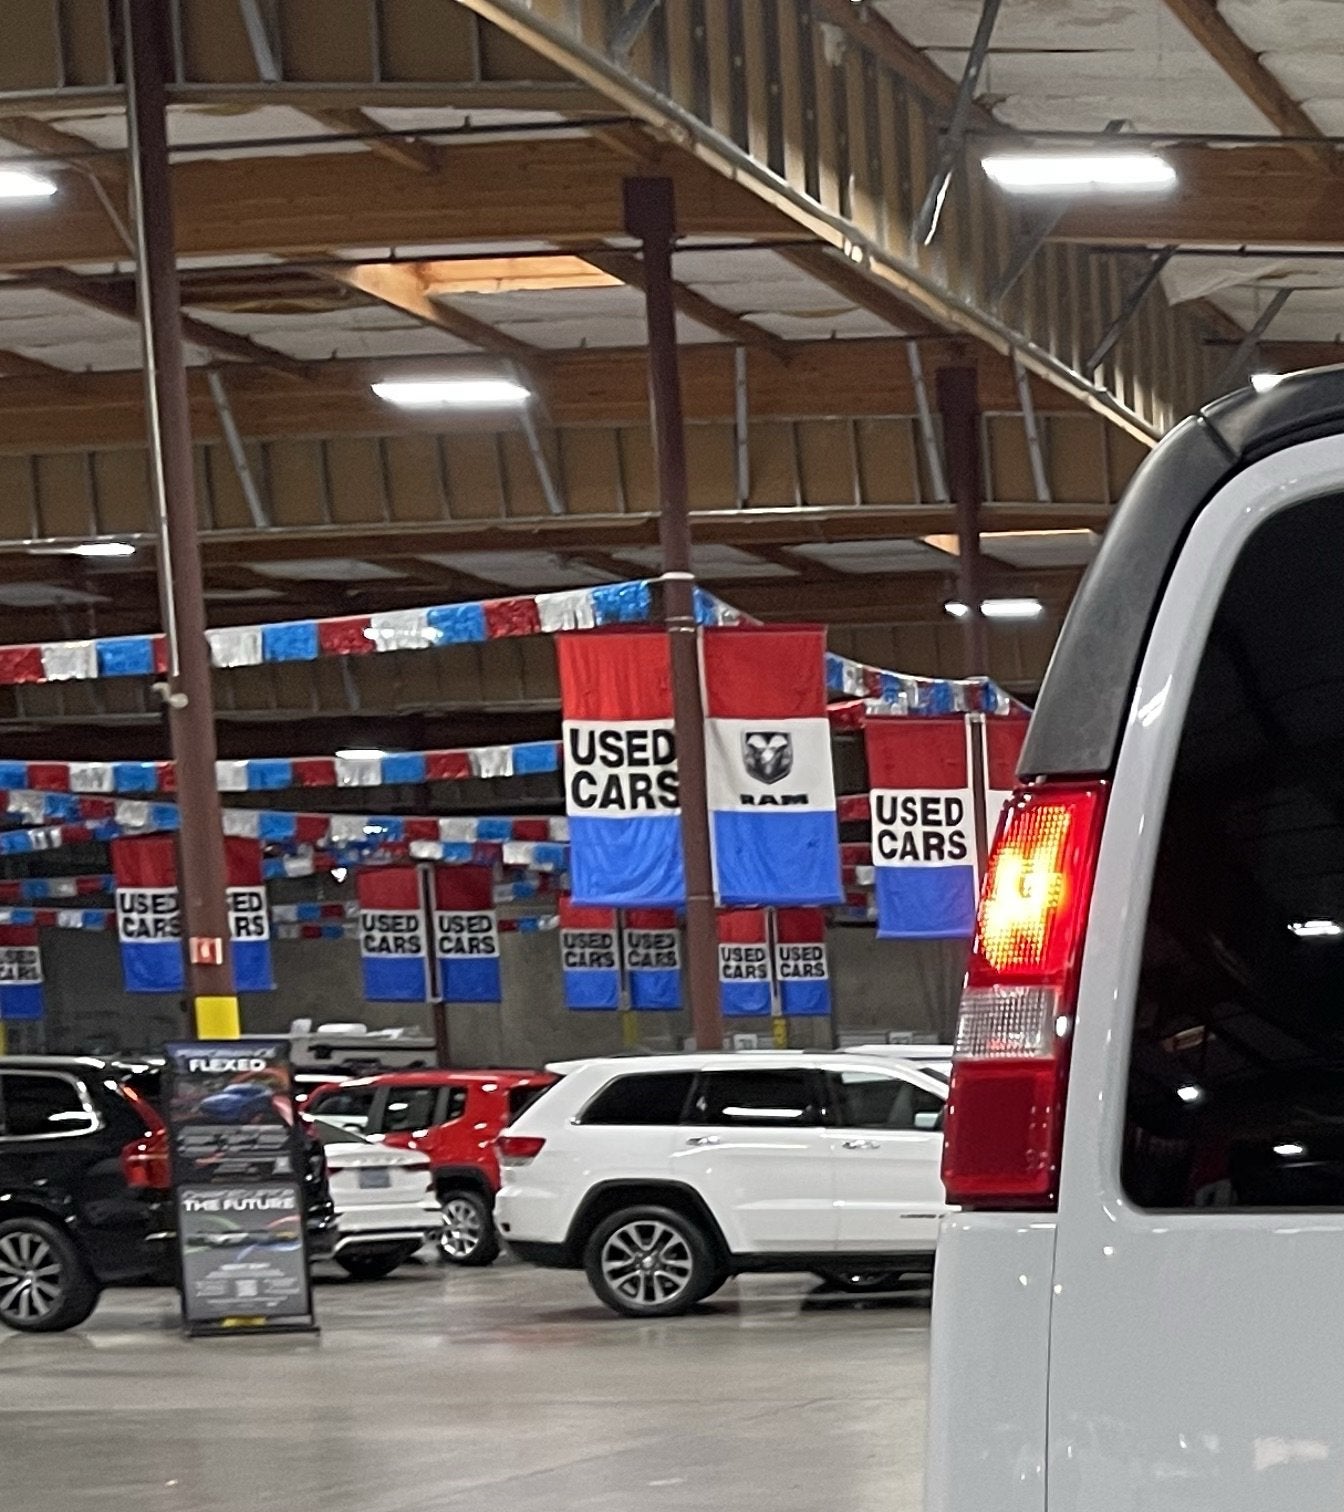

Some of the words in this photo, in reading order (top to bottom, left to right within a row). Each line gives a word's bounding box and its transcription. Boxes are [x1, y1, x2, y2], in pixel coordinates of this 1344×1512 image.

[569, 728, 677, 768] USED
[571, 770, 680, 810] CARS
[740, 794, 809, 805] RAM
[875, 795, 964, 826] USED
[877, 829, 967, 861] CARS
[232, 892, 262, 912] ED
[234, 916, 264, 937] RS
[362, 914, 419, 933] USED
[438, 914, 493, 933] USED
[364, 936, 421, 954] CARS
[438, 936, 496, 954] CARS
[563, 932, 613, 949] USED
[627, 932, 676, 949] USED
[564, 951, 615, 967] CARS
[627, 951, 677, 967] CARS
[720, 947, 765, 962] USED
[779, 946, 823, 961] USED
[722, 964, 767, 979] CARS
[780, 963, 825, 978] CARS
[189, 1058, 266, 1072] FLEXED
[182, 1199, 220, 1211] THE
[223, 1197, 295, 1210] FUTURE
